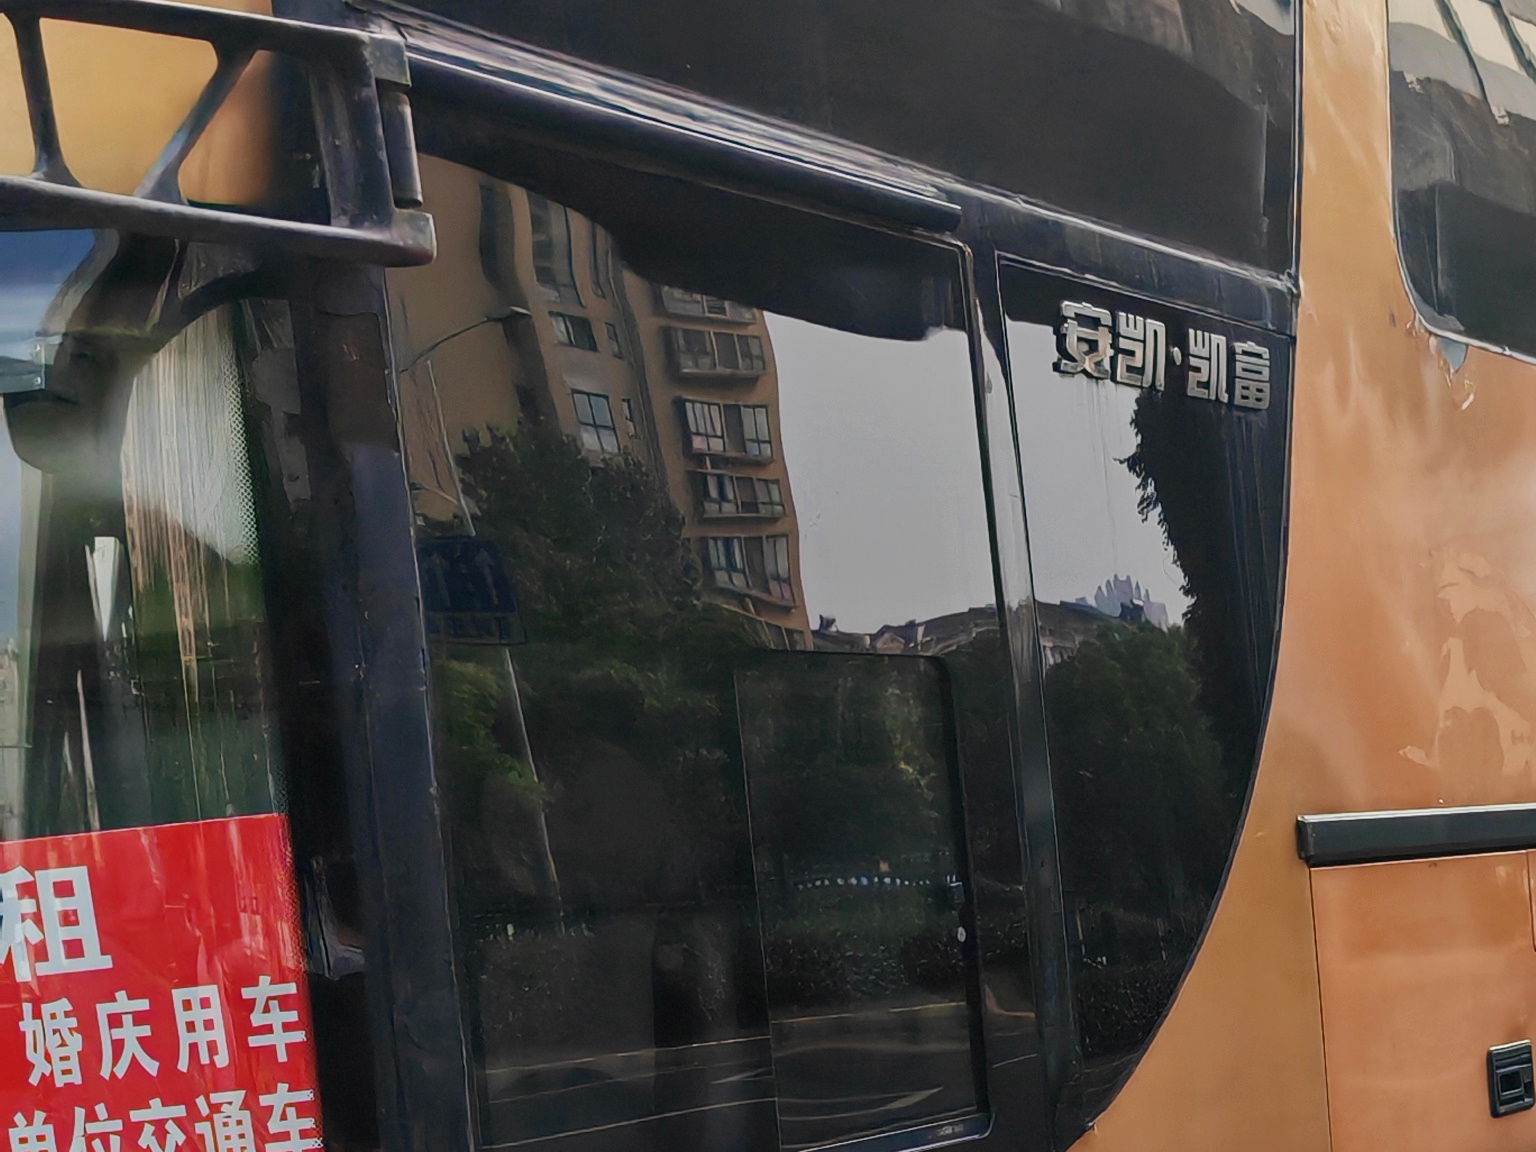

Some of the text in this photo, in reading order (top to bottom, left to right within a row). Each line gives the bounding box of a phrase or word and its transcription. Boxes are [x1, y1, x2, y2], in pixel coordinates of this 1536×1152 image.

[0, 865, 113, 982] 租
[19, 976, 306, 1088] 婚庆用车
